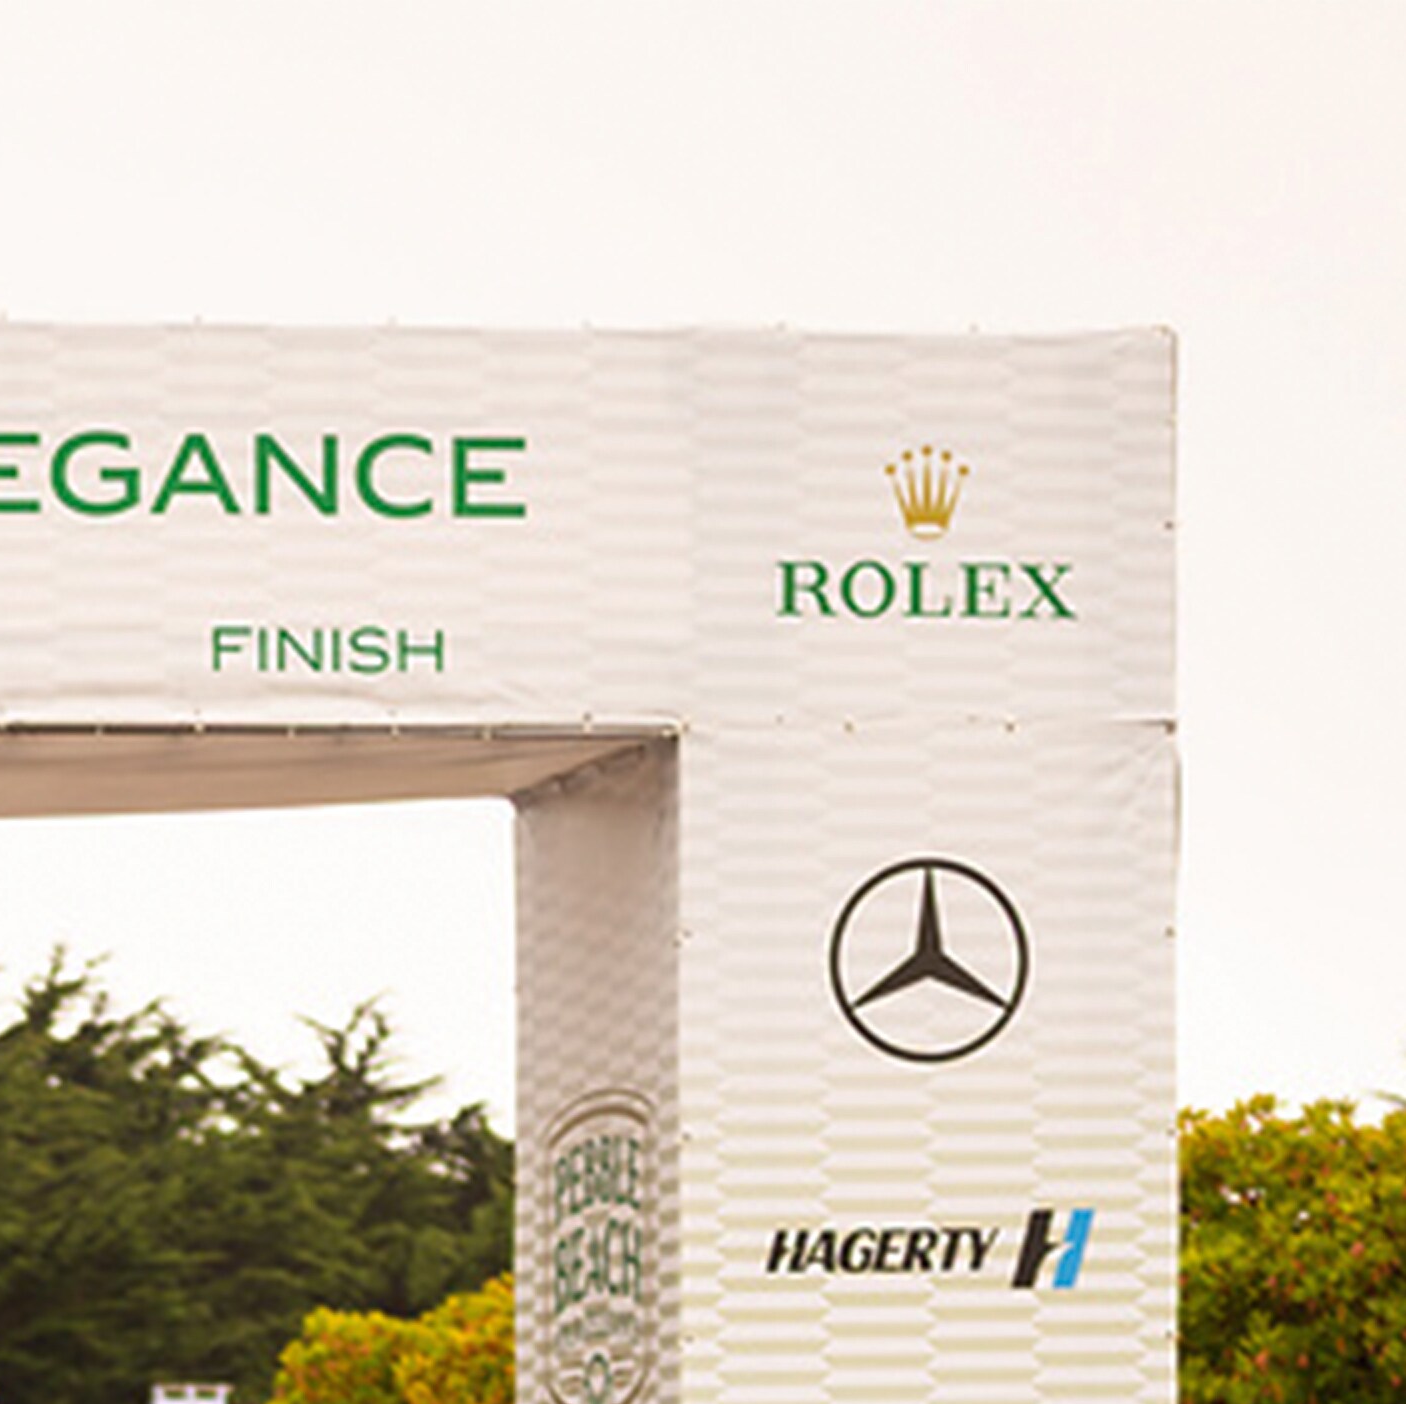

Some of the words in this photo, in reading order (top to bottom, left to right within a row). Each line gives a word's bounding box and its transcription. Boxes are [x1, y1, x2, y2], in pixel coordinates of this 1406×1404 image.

[775, 559, 1077, 620] ROLEX
[212, 625, 445, 674] FINISH
[765, 1227, 999, 1275] HAGERTY
